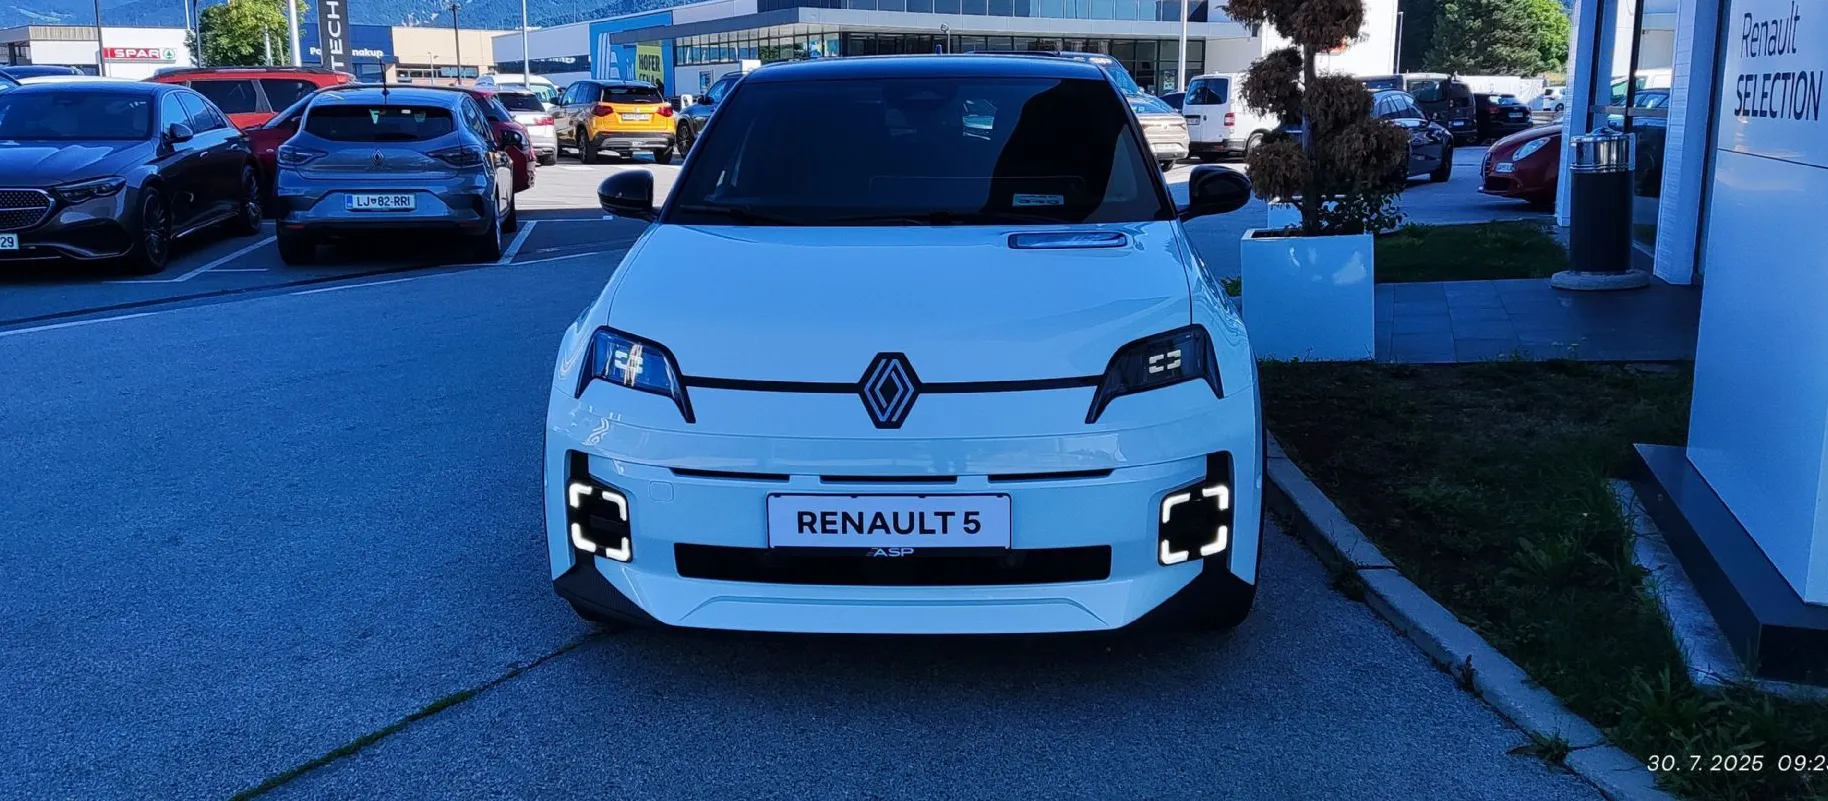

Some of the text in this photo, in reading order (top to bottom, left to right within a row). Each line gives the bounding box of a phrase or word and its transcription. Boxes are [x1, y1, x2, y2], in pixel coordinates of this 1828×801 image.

[326, 1, 344, 71] TECH
[1740, 0, 1800, 58] Renault
[114, 48, 160, 59] SPAR
[352, 47, 384, 59] nakup
[638, 54, 661, 72] HOFER
[1734, 70, 1823, 121] SELECTION
[357, 195, 370, 207] LJ
[797, 511, 981, 535] RENAULT 5
[873, 547, 915, 557] ASP
